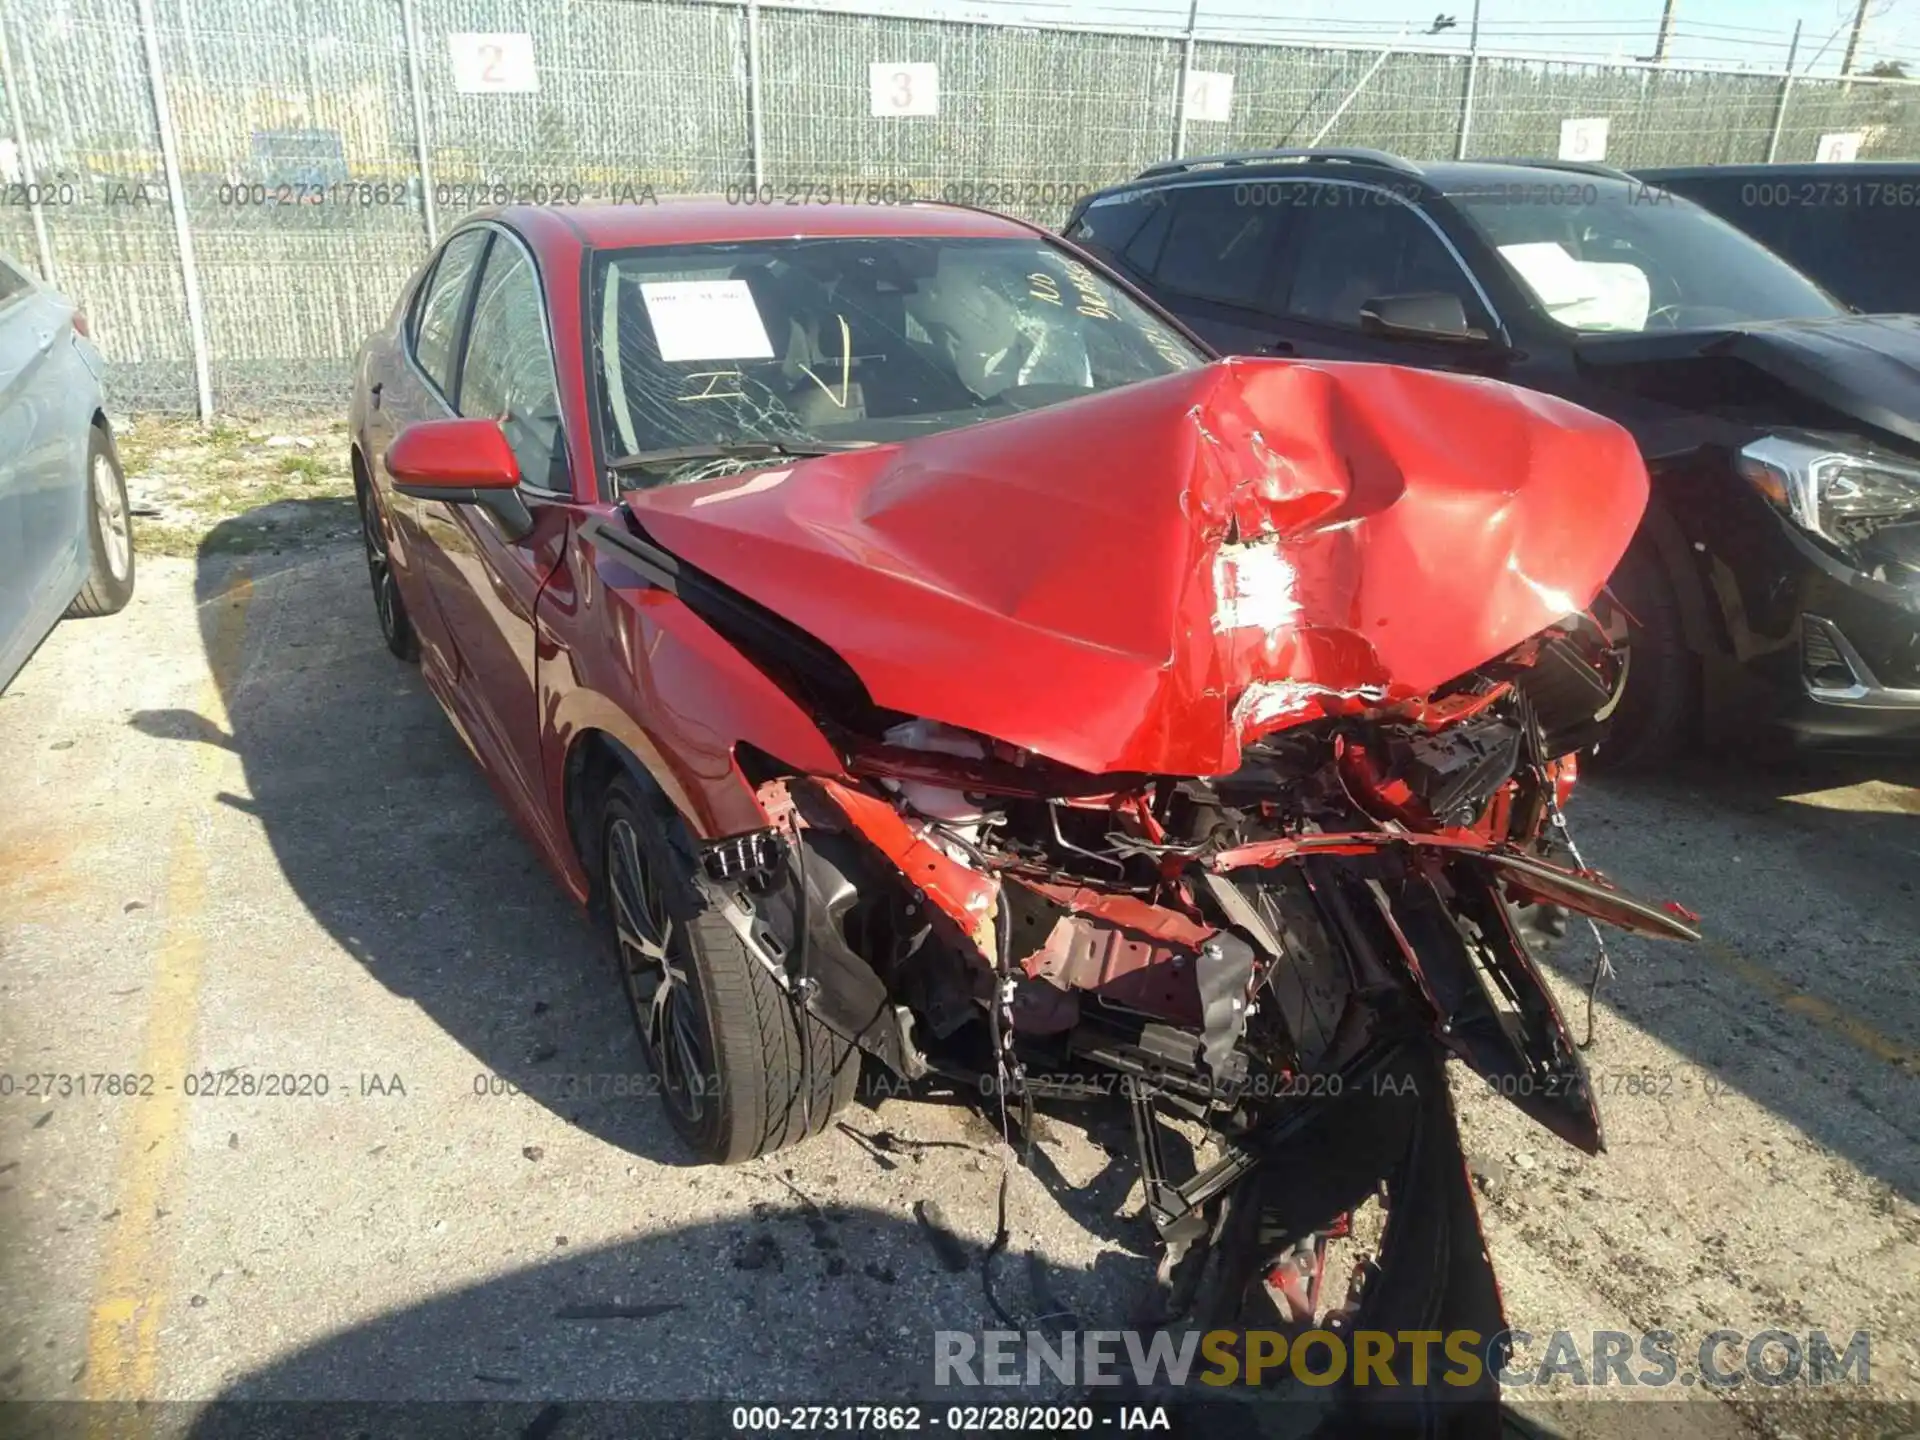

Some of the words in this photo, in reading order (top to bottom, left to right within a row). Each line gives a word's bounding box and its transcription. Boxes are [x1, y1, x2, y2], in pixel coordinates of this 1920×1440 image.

[477, 43, 506, 83] 2
[890, 71, 914, 109] 3
[1191, 81, 1212, 114] 4
[1573, 126, 1591, 155] 5
[1828, 141, 1844, 163] 6
